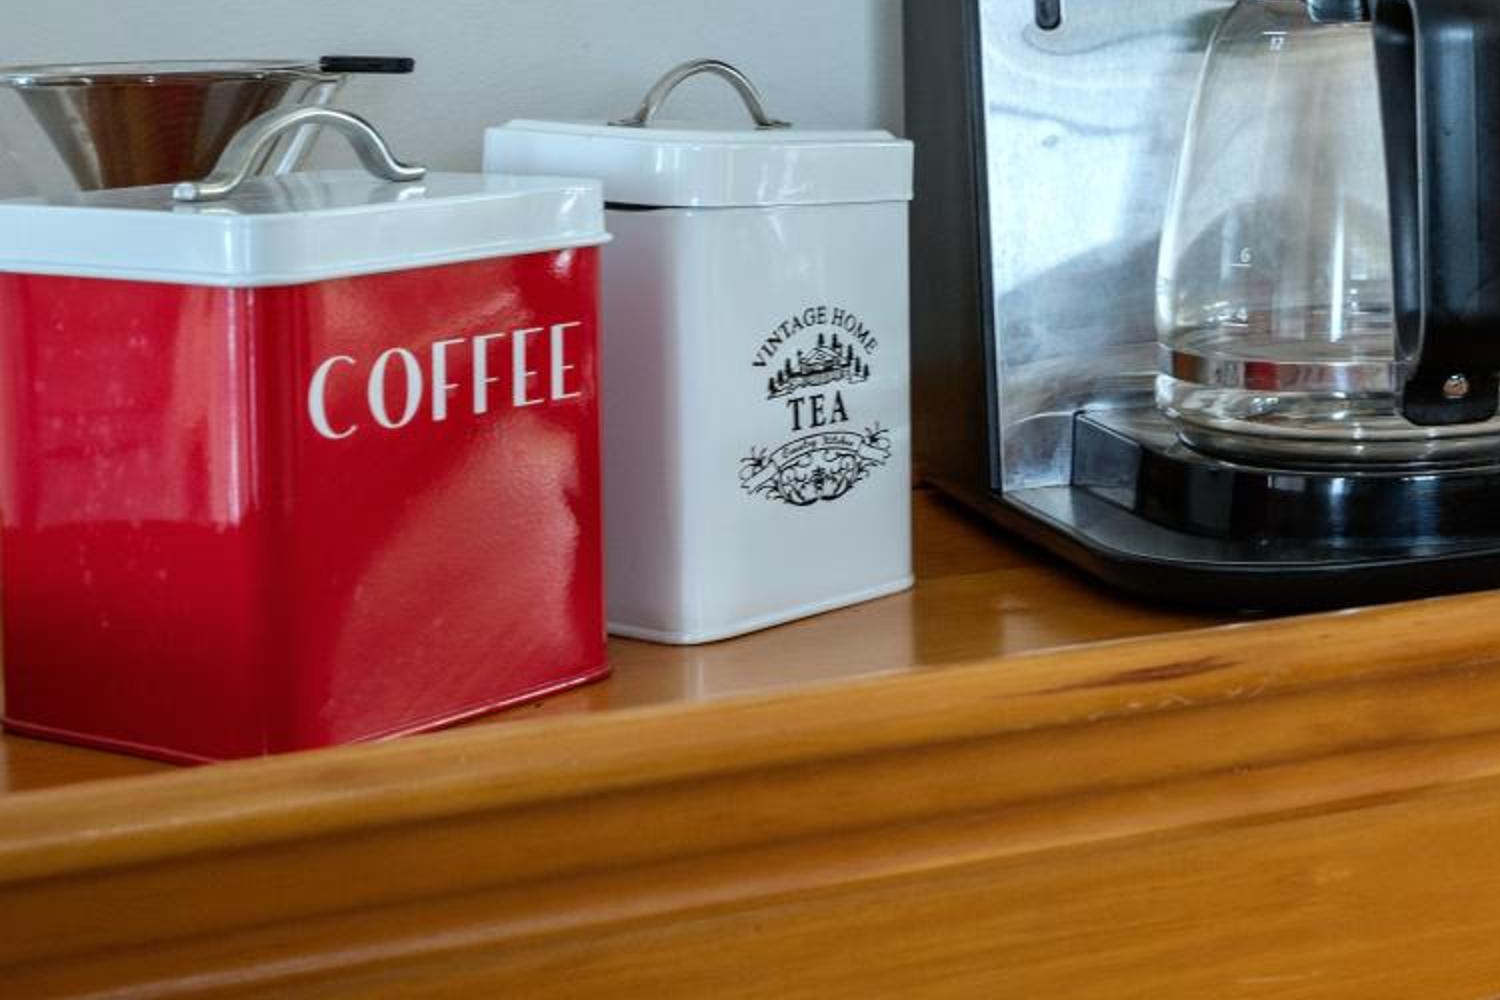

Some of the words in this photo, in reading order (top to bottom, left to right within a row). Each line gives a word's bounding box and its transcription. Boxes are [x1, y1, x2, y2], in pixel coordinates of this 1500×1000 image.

[1240, 247, 1251, 262] 6
[752, 306, 826, 368] VINTAGE
[831, 307, 879, 355] HOME
[308, 321, 582, 440] COFFEE
[786, 390, 849, 431] TEA
